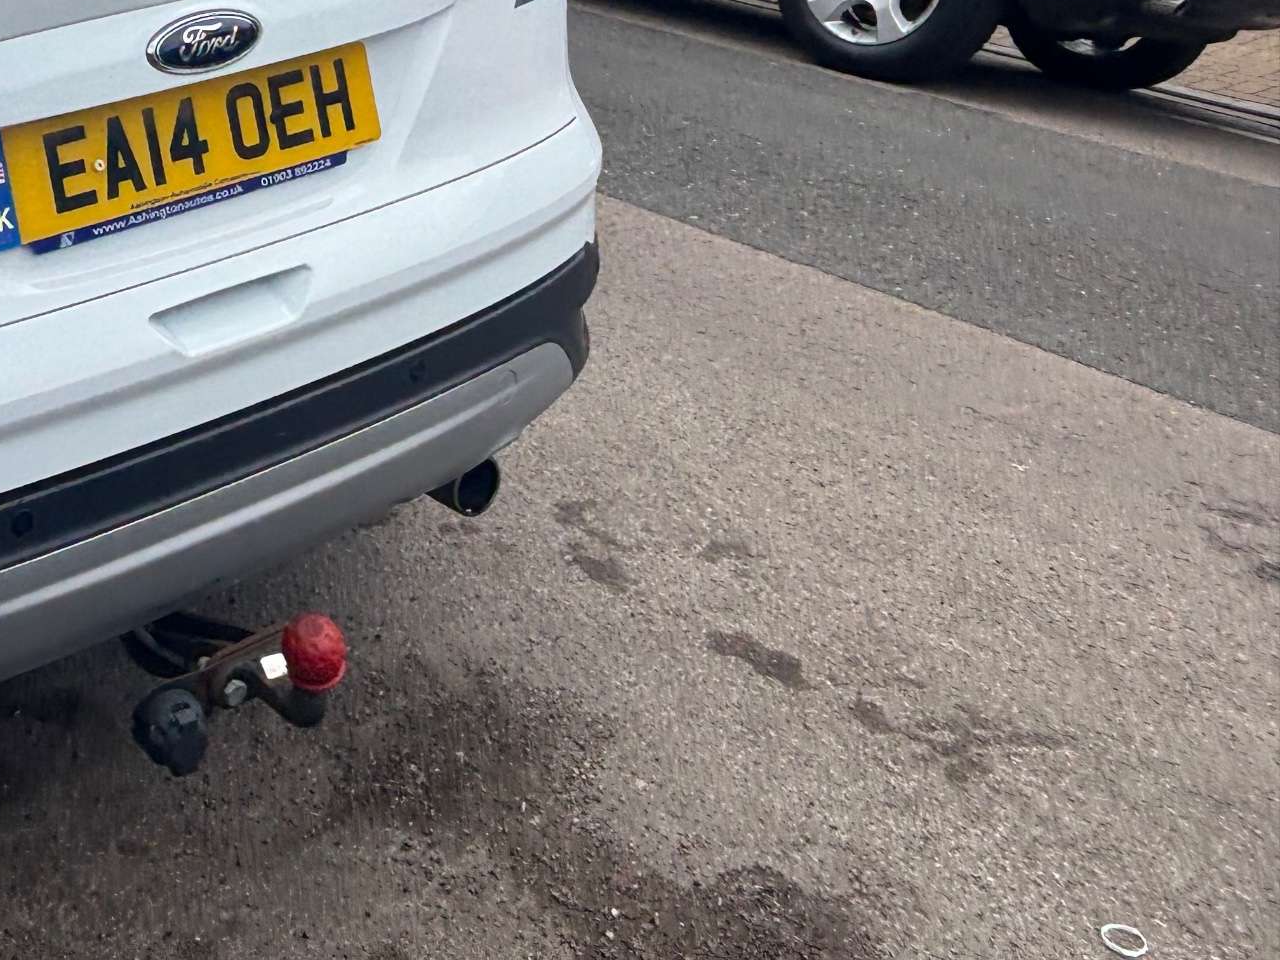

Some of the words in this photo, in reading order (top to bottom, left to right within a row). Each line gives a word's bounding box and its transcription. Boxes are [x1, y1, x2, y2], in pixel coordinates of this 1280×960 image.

[179, 22, 240, 61] Ford
[42, 96, 210, 215] EA14
[225, 57, 356, 160] OEH
